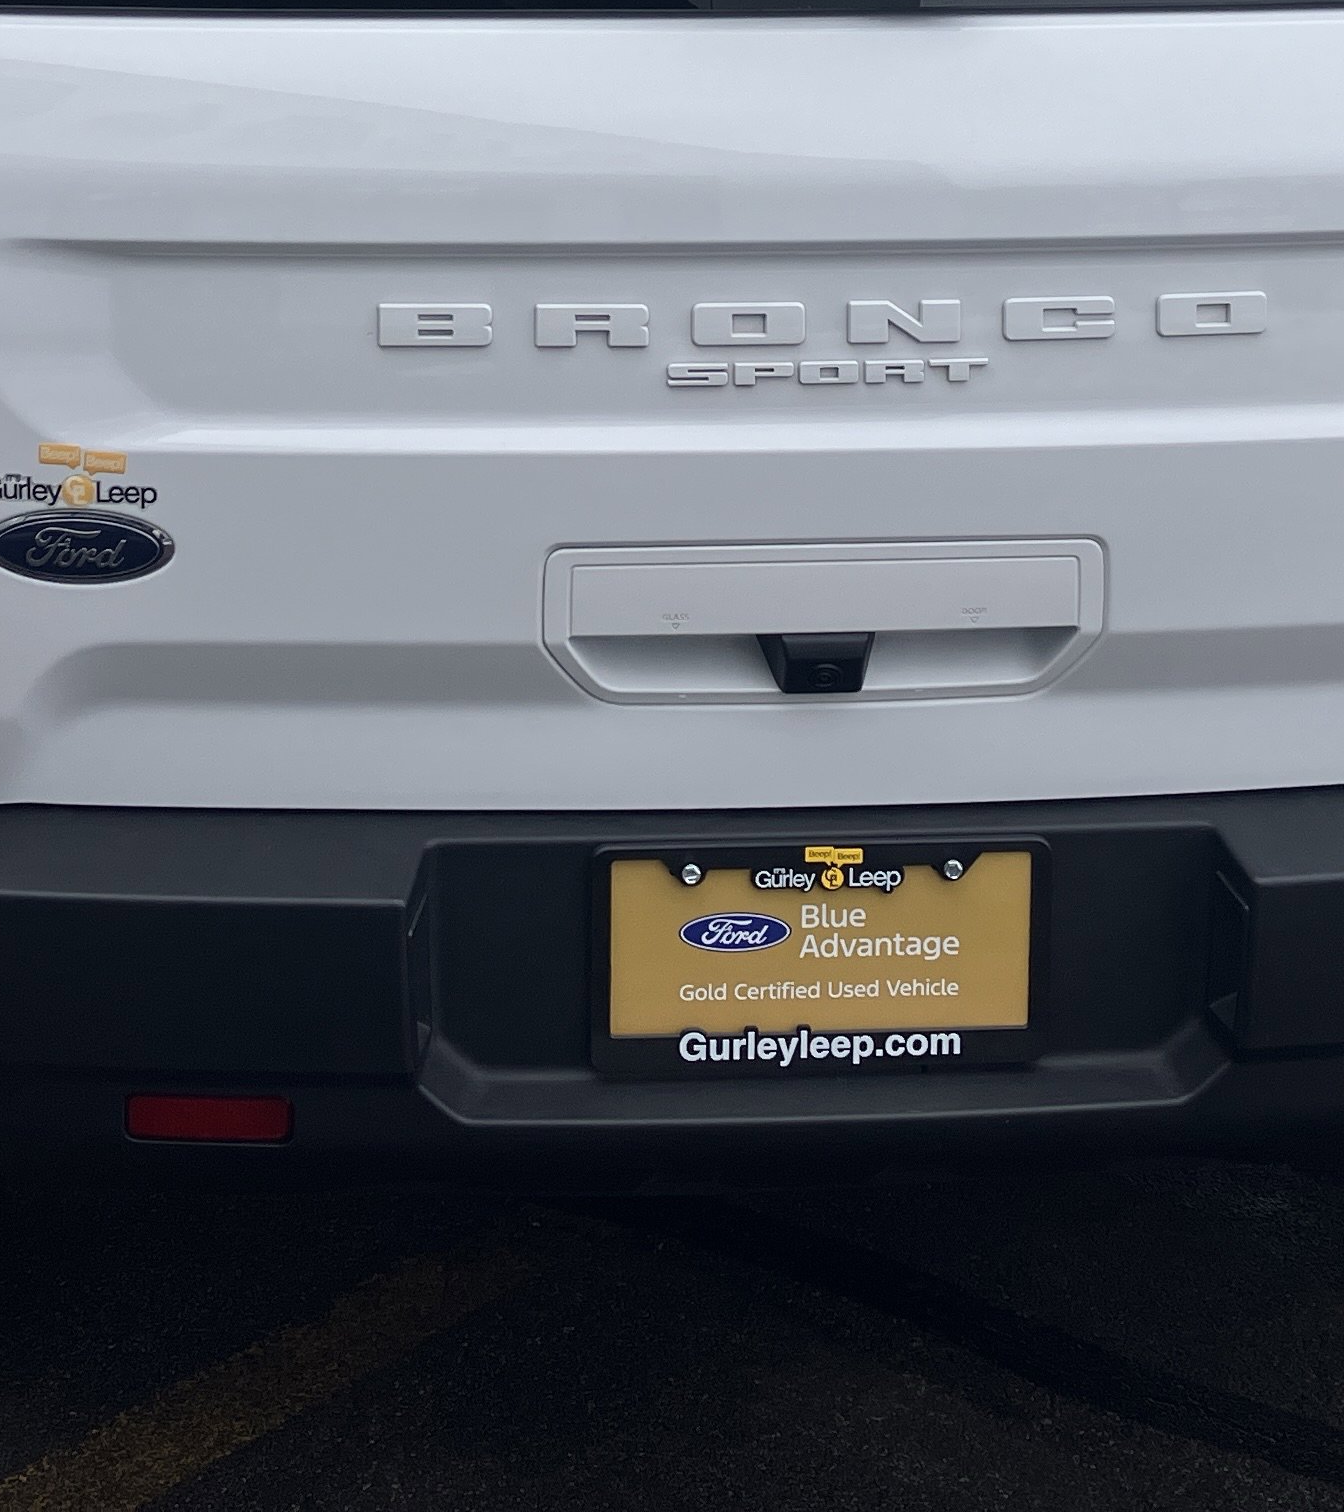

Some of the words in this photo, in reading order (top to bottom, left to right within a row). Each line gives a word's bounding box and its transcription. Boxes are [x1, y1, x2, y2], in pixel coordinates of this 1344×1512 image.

[377, 291, 1268, 349] BRONCO
[667, 357, 989, 388] SPORT
[96, 480, 158, 509] Leep
[25, 526, 127, 568] Ford
[756, 869, 816, 892] Gurley
[849, 868, 902, 892] Leep
[701, 918, 769, 946] Ford
[801, 904, 867, 929] Blue
[799, 933, 961, 961] Advantage
[679, 983, 727, 1001] Gold
[734, 980, 821, 1000] Certified
[828, 980, 880, 998] Used
[887, 978, 960, 997] Vehicle
[678, 1030, 962, 1067] Gurleyleep.com
